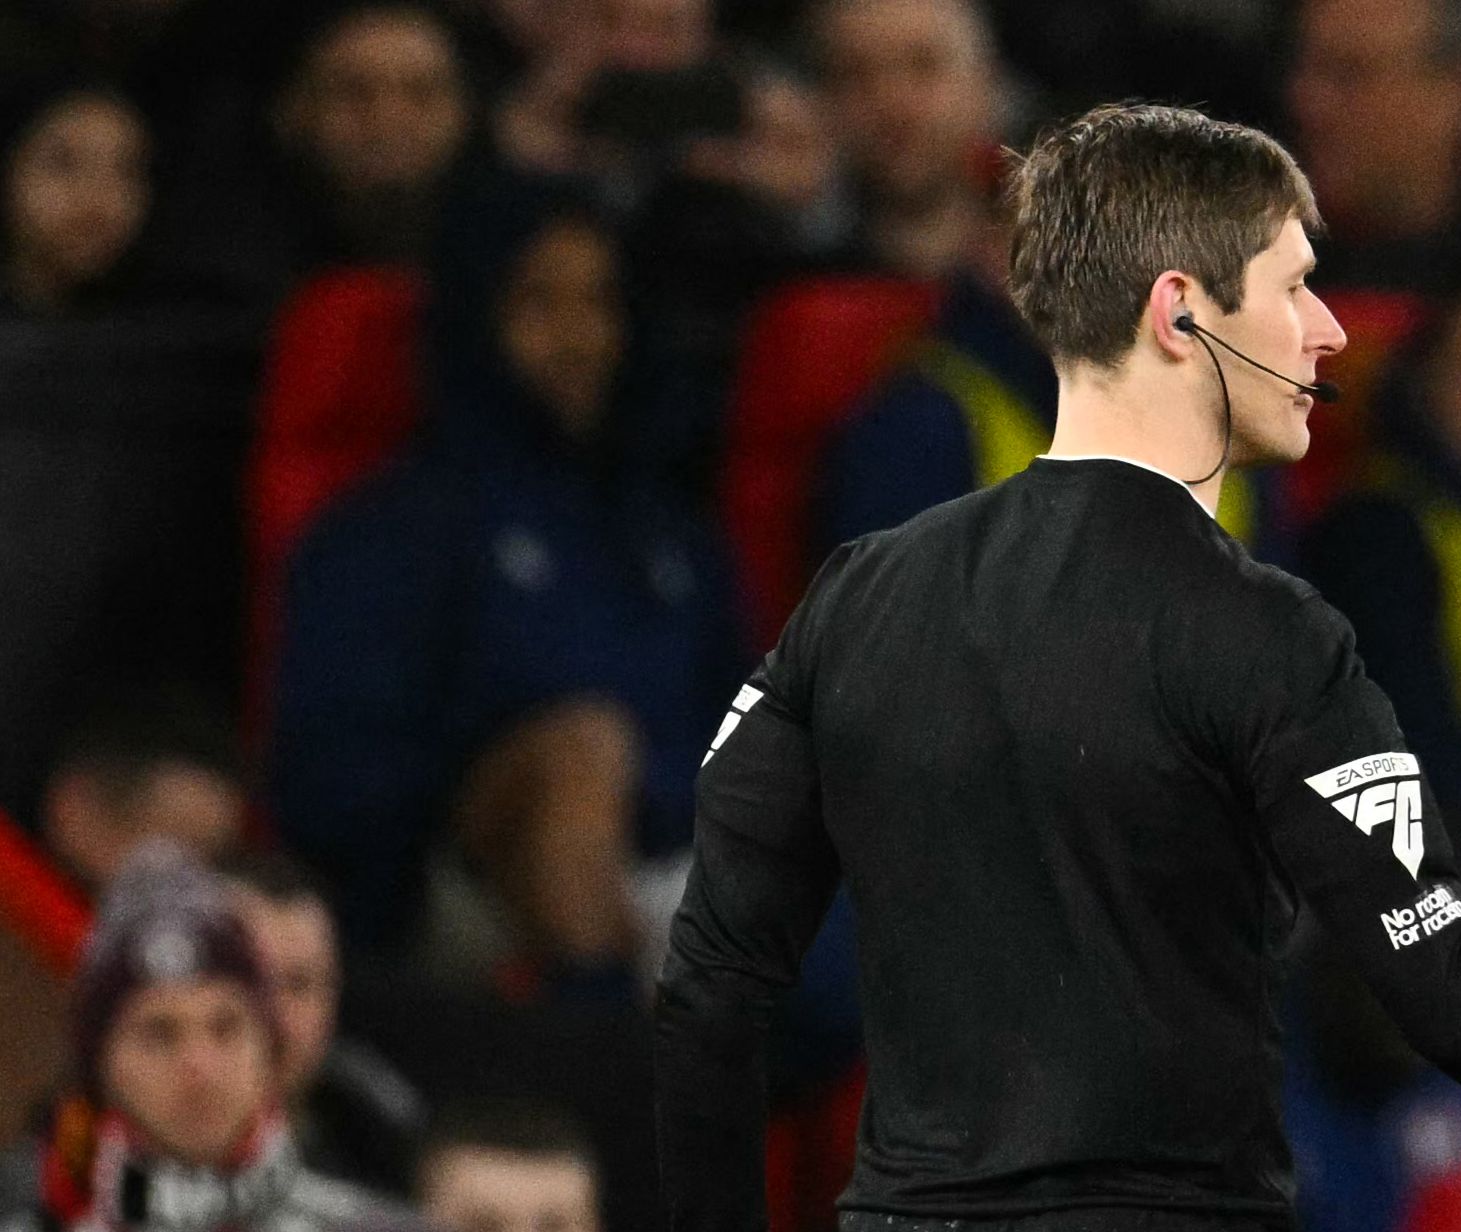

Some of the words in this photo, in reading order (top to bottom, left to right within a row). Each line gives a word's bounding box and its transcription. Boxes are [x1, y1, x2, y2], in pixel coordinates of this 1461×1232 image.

[1361, 756, 1409, 777] SPORS
[1380, 908, 1415, 936] No
[1389, 924, 1420, 951] for
